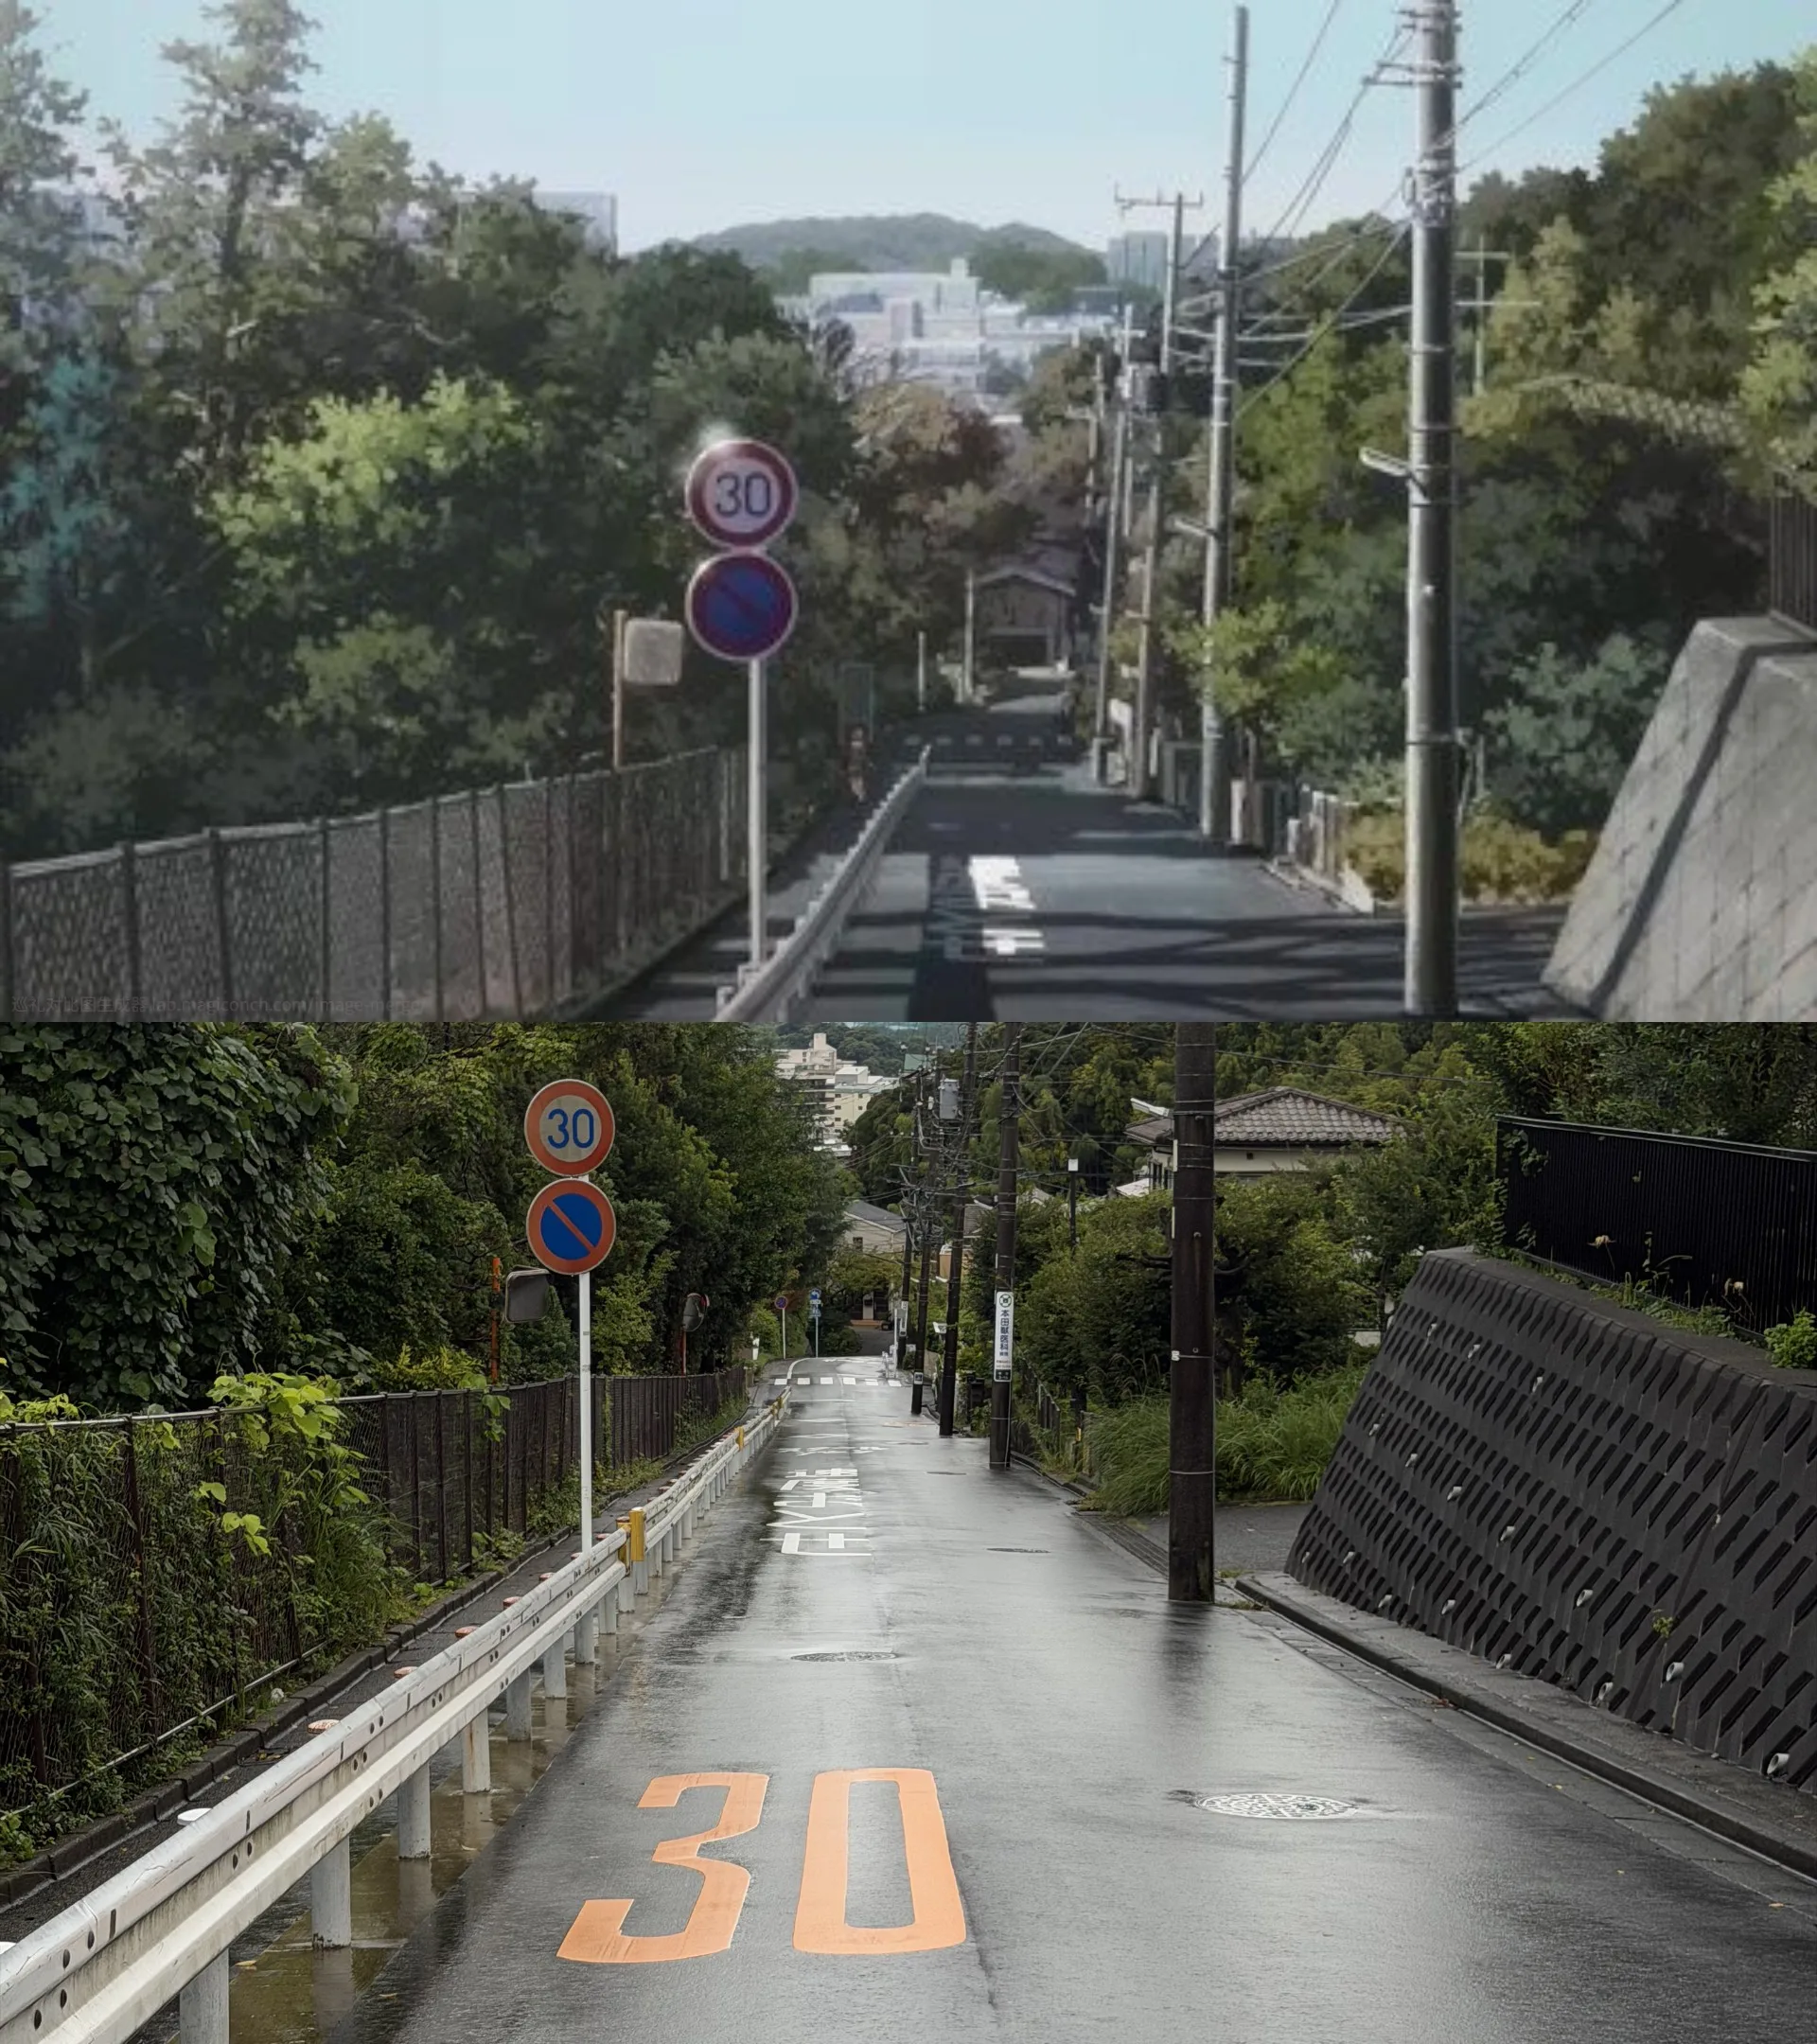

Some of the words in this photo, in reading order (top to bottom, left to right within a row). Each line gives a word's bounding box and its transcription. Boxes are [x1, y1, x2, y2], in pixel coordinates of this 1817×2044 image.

[716, 472, 770, 516] 30
[548, 1108, 594, 1149] 30
[556, 1767, 966, 1964] 30
